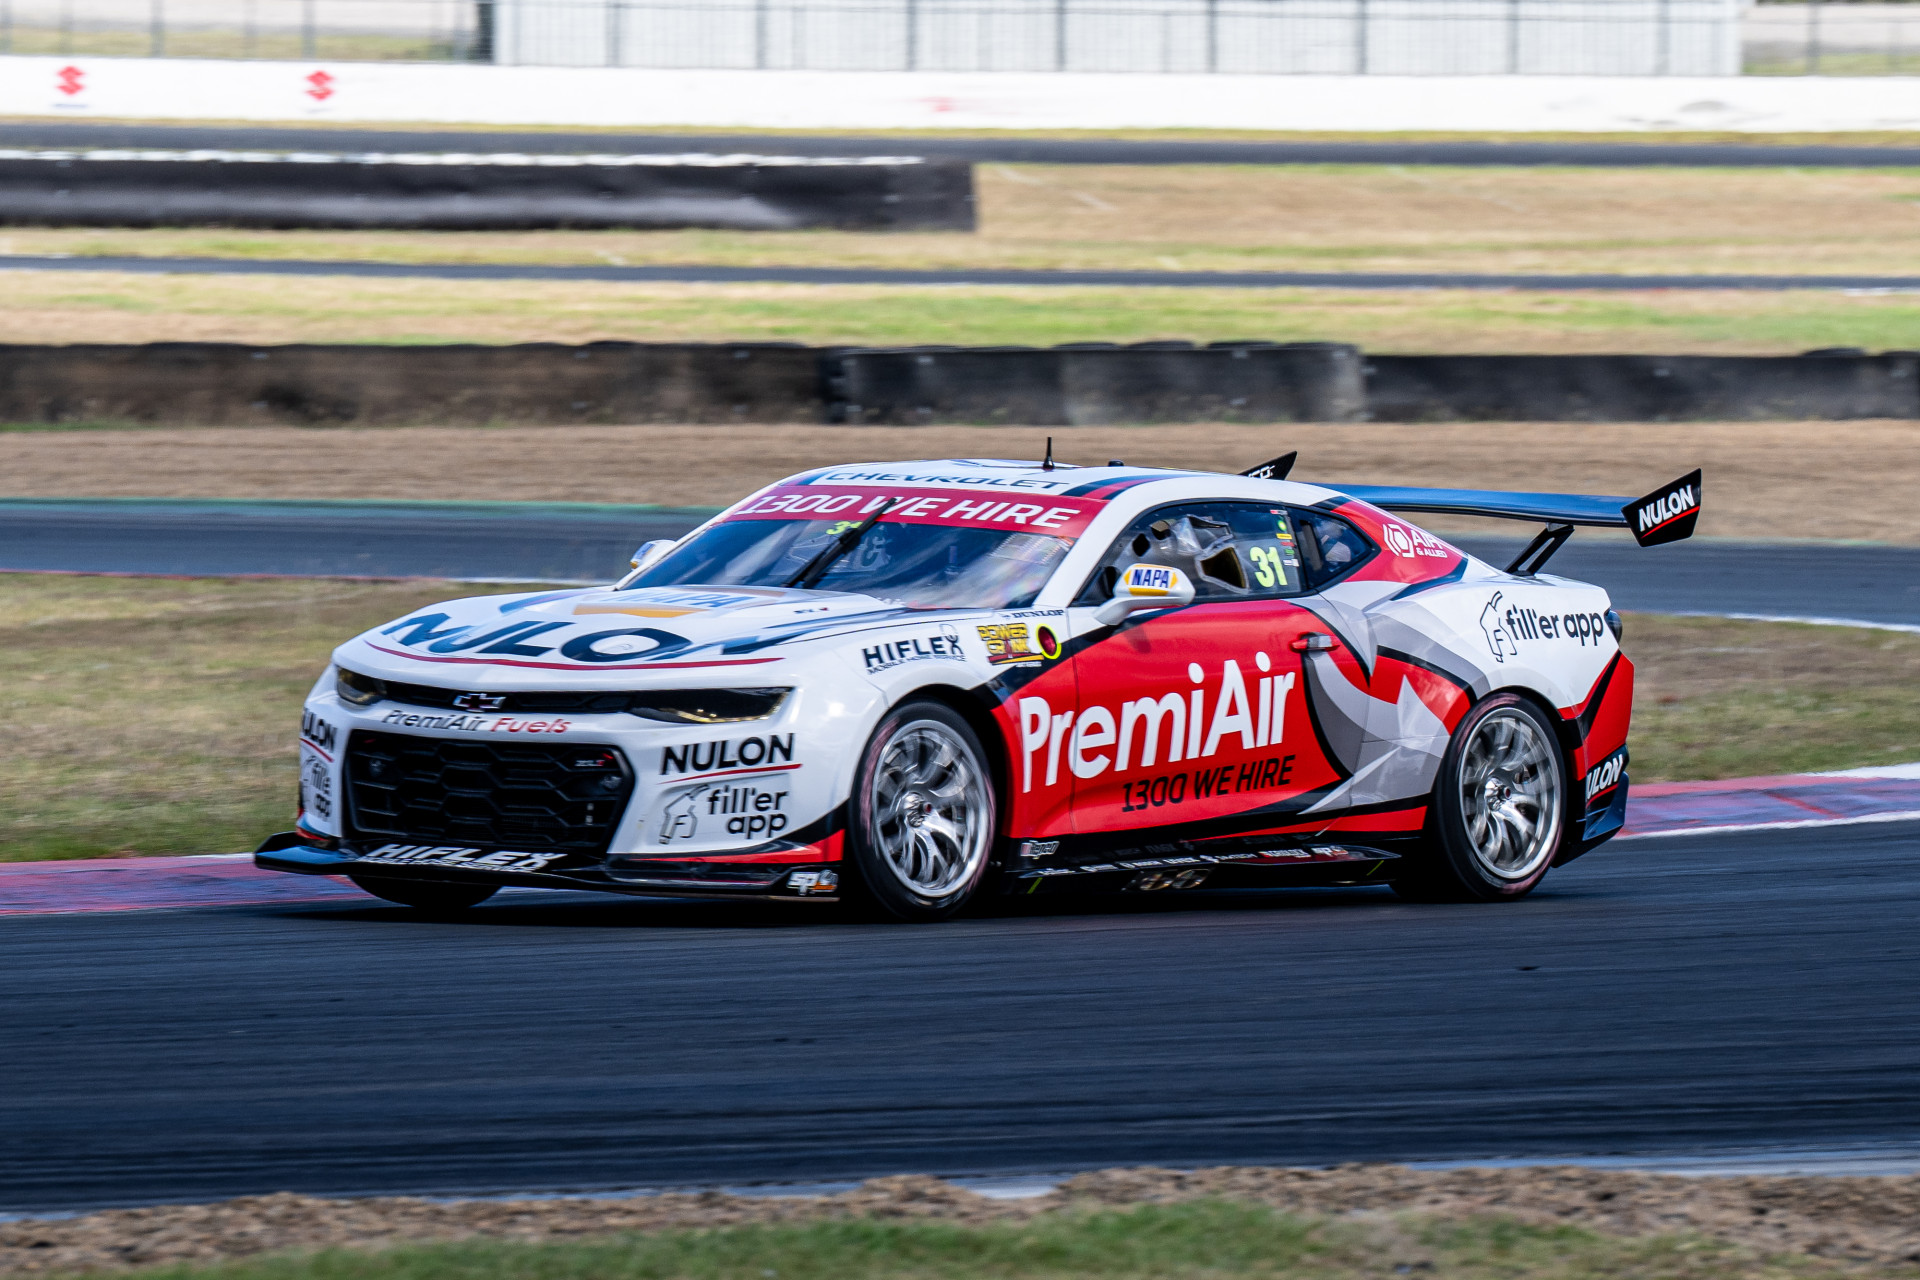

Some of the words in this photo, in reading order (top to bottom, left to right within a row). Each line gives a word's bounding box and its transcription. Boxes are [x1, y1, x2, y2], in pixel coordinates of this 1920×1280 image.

[824, 471, 1070, 490] CHEVROLET
[734, 494, 863, 516] 1300
[939, 499, 1081, 529] HIRE
[1638, 485, 1696, 532] NULON
[1130, 568, 1170, 589] NAPA
[1249, 546, 1289, 588] 31
[1011, 609, 1064, 619] DUNLOP
[1563, 611, 1604, 646] app
[862, 634, 964, 668] HIFLEX
[382, 709, 488, 732] PremiAir
[489, 717, 572, 733] Fuels
[1019, 651, 1296, 794] PremiAir
[660, 732, 795, 776] NULON
[1121, 771, 1188, 813] 1300
[1193, 765, 1236, 800] WE
[1235, 754, 1296, 791] HIRE
[1585, 753, 1624, 800] ULON
[726, 813, 788, 840] app
[368, 844, 568, 871] HIFLEX
